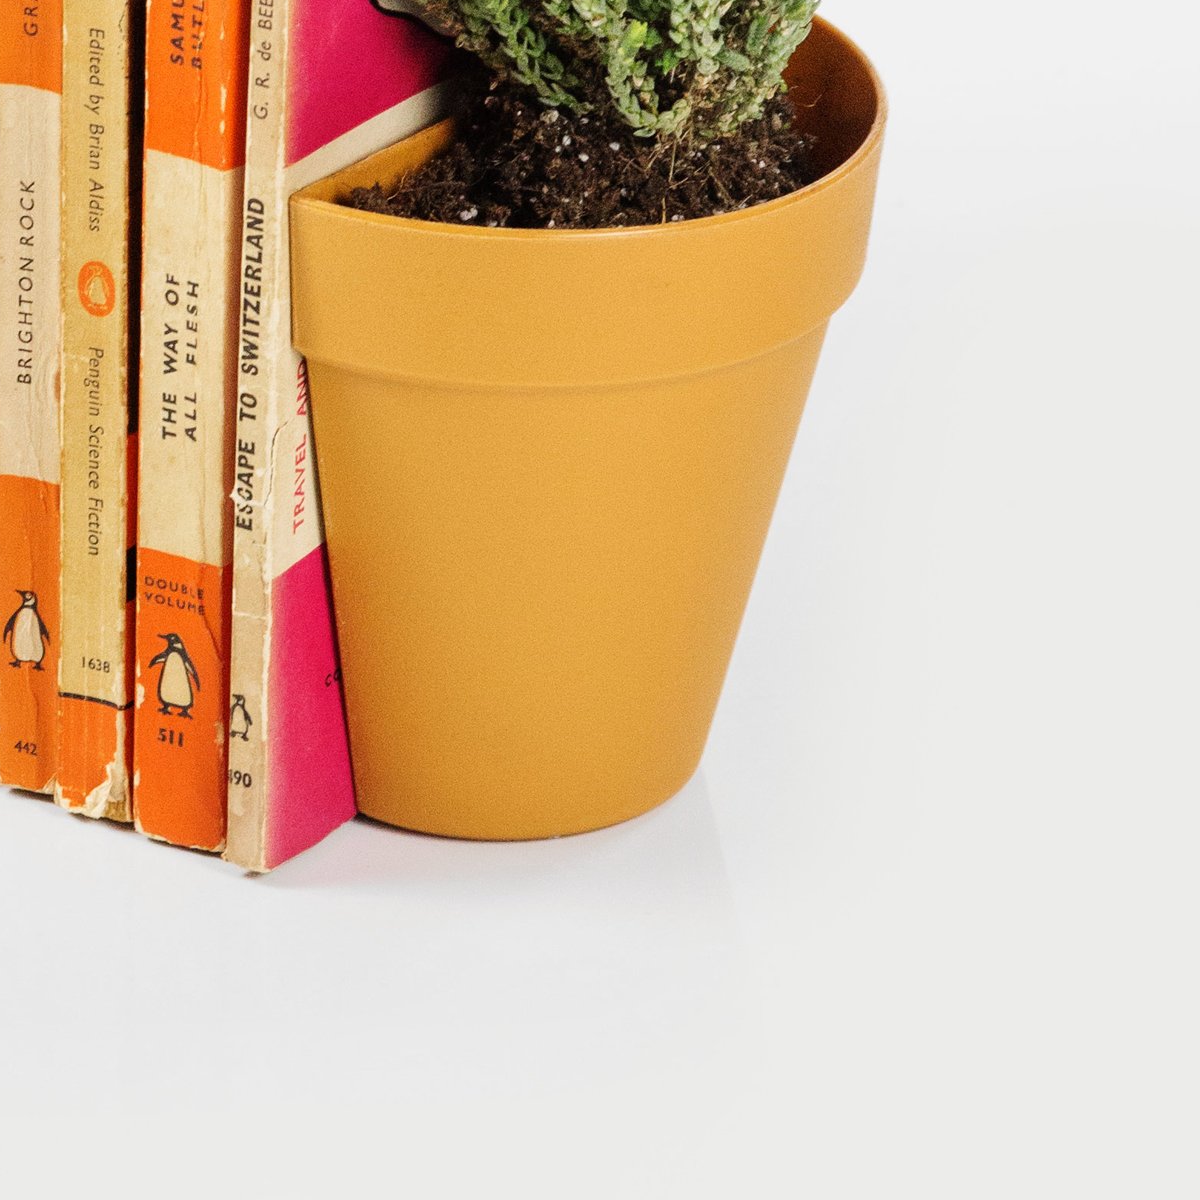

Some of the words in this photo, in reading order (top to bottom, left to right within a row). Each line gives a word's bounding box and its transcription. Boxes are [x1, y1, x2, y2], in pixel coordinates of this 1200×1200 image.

[88, 27, 105, 84] Edited
[257, 41, 272, 61] de
[84, 88, 105, 116] by
[255, 72, 270, 89] R.
[253, 102, 269, 120] G.
[88, 124, 105, 170] Brian
[19, 180, 35, 247] ROCK
[88, 178, 105, 233] Aldiss
[165, 273, 181, 306] OF
[241, 197, 265, 376] SWITZERLAND
[17, 257, 34, 384] BRIGHTON
[185, 280, 200, 365] FLESH
[163, 323, 178, 375] WAY
[83, 346, 105, 416] Penguin
[162, 392, 178, 440] THE
[183, 391, 198, 442] ALL
[240, 392, 258, 421] TO
[88, 425, 105, 490] Science
[236, 439, 256, 531] ESCAPE
[293, 434, 307, 534] TRAVEL
[88, 497, 104, 556] Fiction
[144, 576, 205, 599] DOUBLE
[144, 592, 206, 615] VOLUME
[81, 657, 111, 673] 1638
[14, 740, 37, 756] 442
[157, 727, 184, 747] 511
[229, 769, 252, 788] 90
